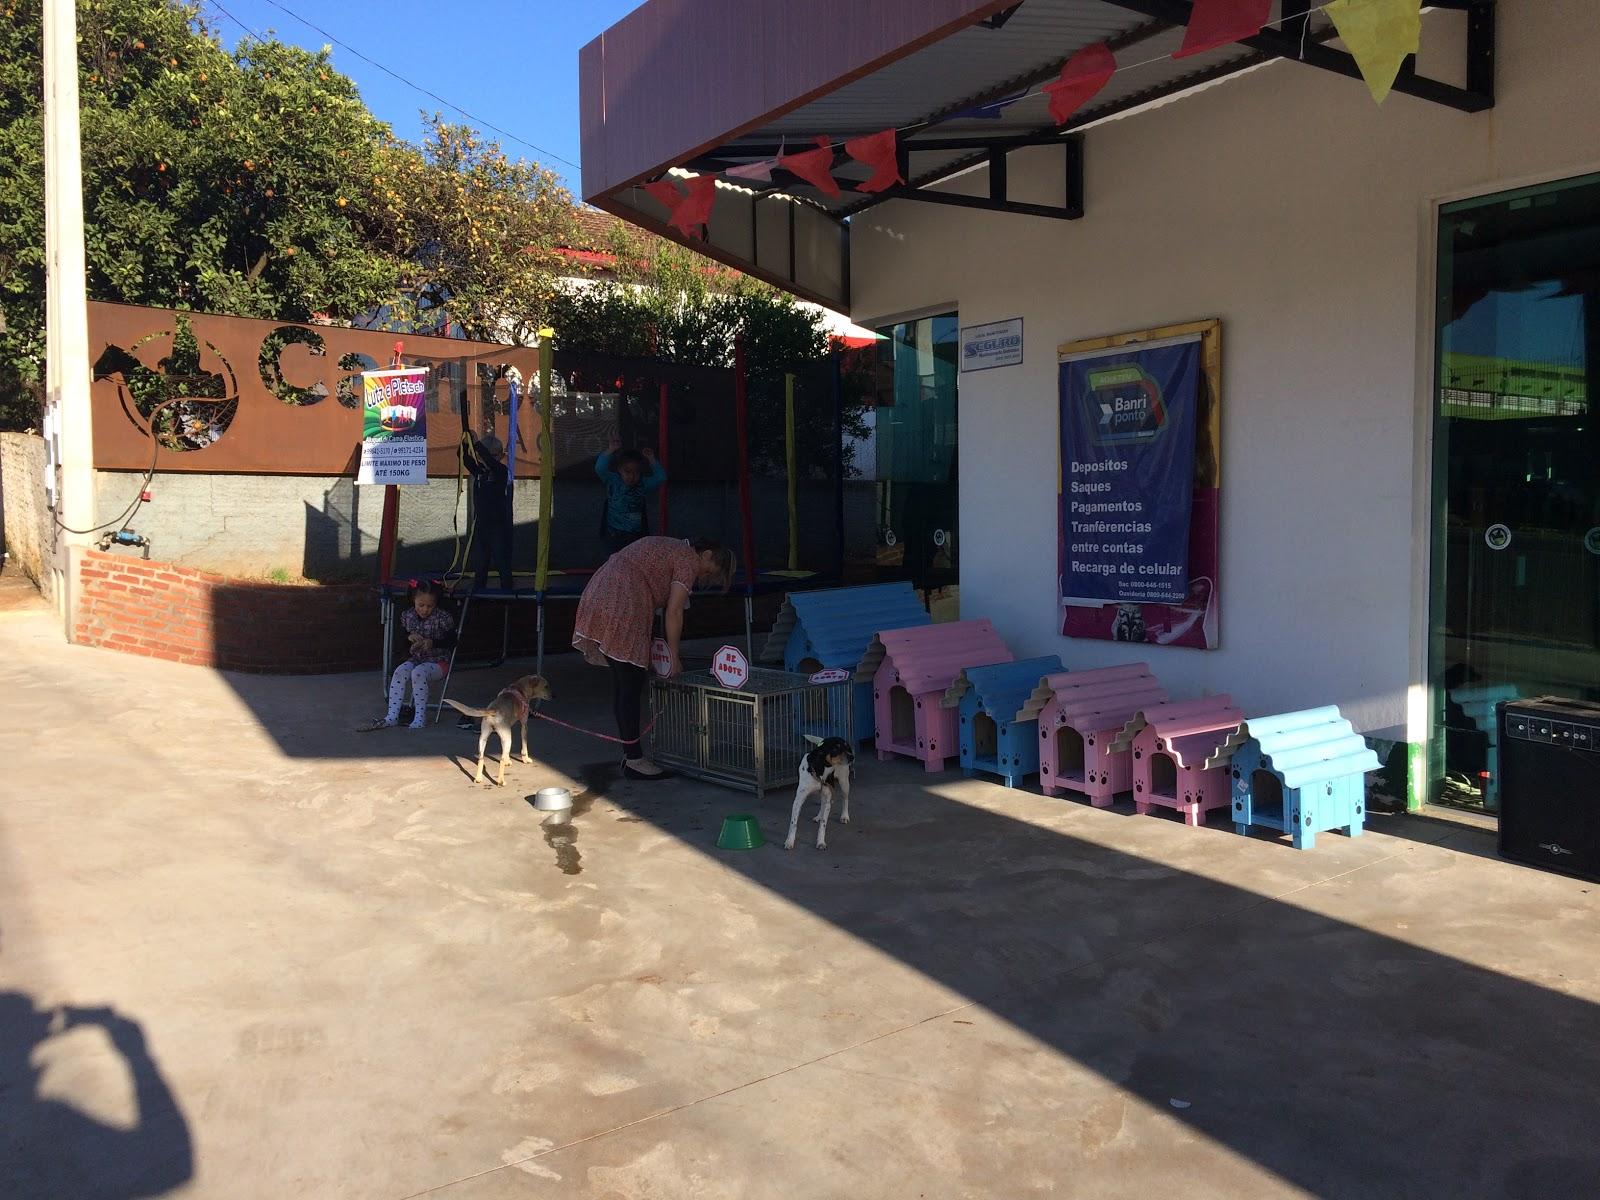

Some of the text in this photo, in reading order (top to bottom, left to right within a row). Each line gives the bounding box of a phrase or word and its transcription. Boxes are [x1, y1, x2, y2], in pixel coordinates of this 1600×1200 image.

[365, 386, 384, 409] Lutz
[391, 378, 425, 397] Pletsch
[1115, 394, 1147, 411] Banri
[1115, 411, 1146, 426] ponto
[388, 435, 403, 443] Cama
[389, 469, 410, 477] 150KG
[1071, 460, 1128, 475] Depositos
[1071, 481, 1111, 495] Saques
[1071, 500, 1142, 516] Pagamentos
[1071, 542, 1144, 554] entre contas
[1071, 561, 1183, 576] Recarga de celular
[1119, 590, 1146, 598] Ouvidoria
[718, 663, 743, 677] ADOTE
